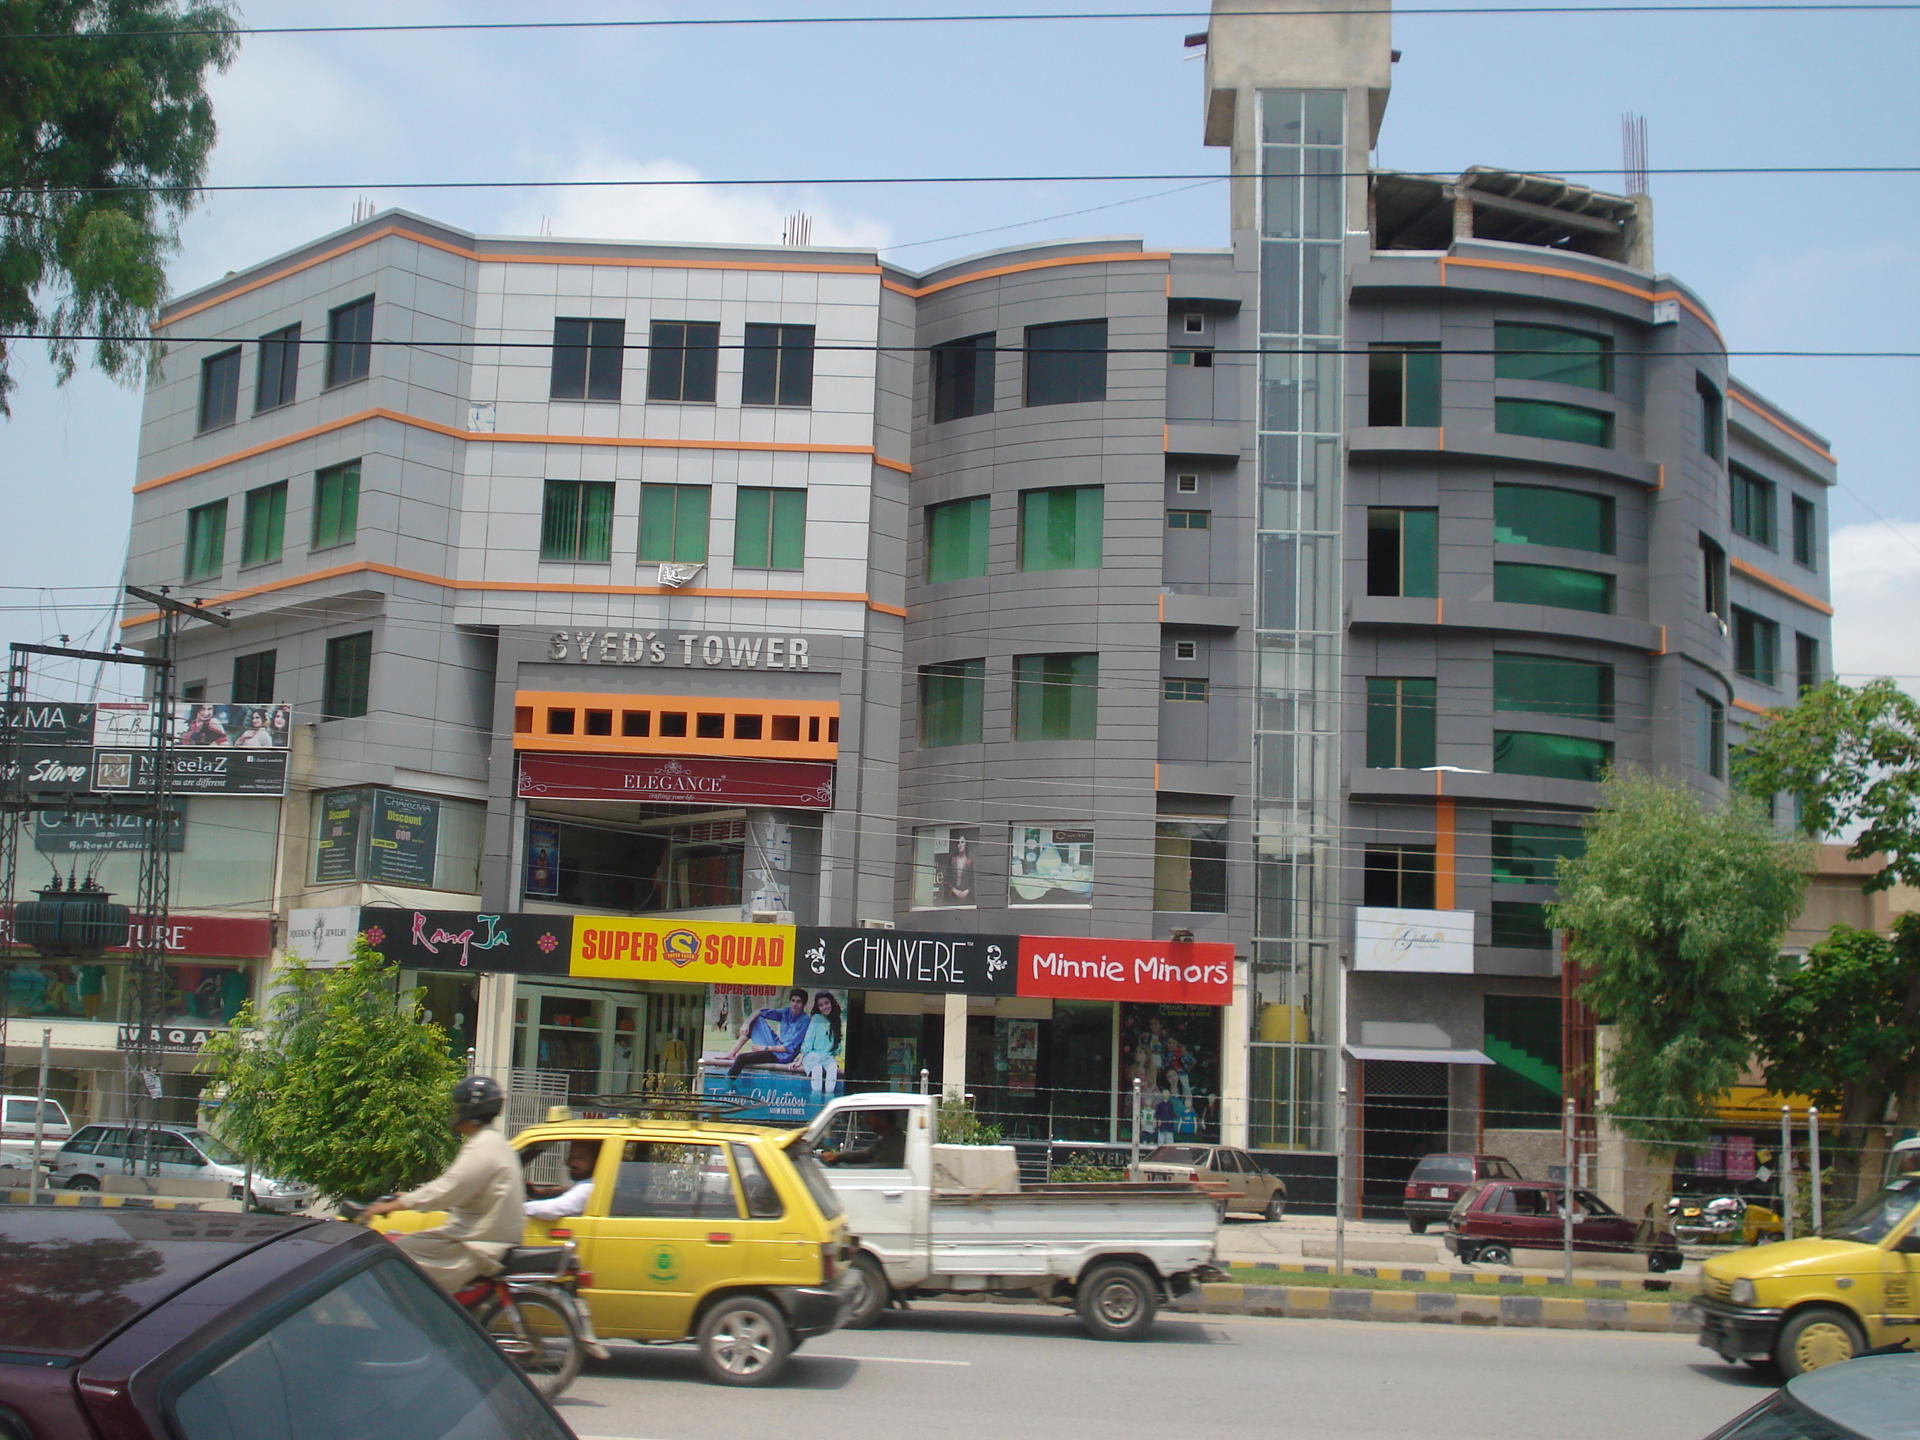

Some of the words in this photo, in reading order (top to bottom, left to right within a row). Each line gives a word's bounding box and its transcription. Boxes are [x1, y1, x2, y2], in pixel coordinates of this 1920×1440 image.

[549, 630, 666, 664] SYED's
[678, 634, 809, 668] TOWER
[28, 759, 86, 782] Store
[624, 773, 722, 792] ELEGANCE
[387, 810, 422, 826] Discount
[412, 912, 474, 966] Rang
[582, 929, 658, 962] SUPER
[704, 934, 784, 968] SQUAD
[841, 937, 967, 983] CHINYERE
[1033, 952, 1126, 982] Minnie
[1134, 957, 1229, 984] Minors
[714, 984, 743, 995] SUPER
[746, 985, 777, 996] SQUAD
[750, 1088, 807, 1107] Collection
